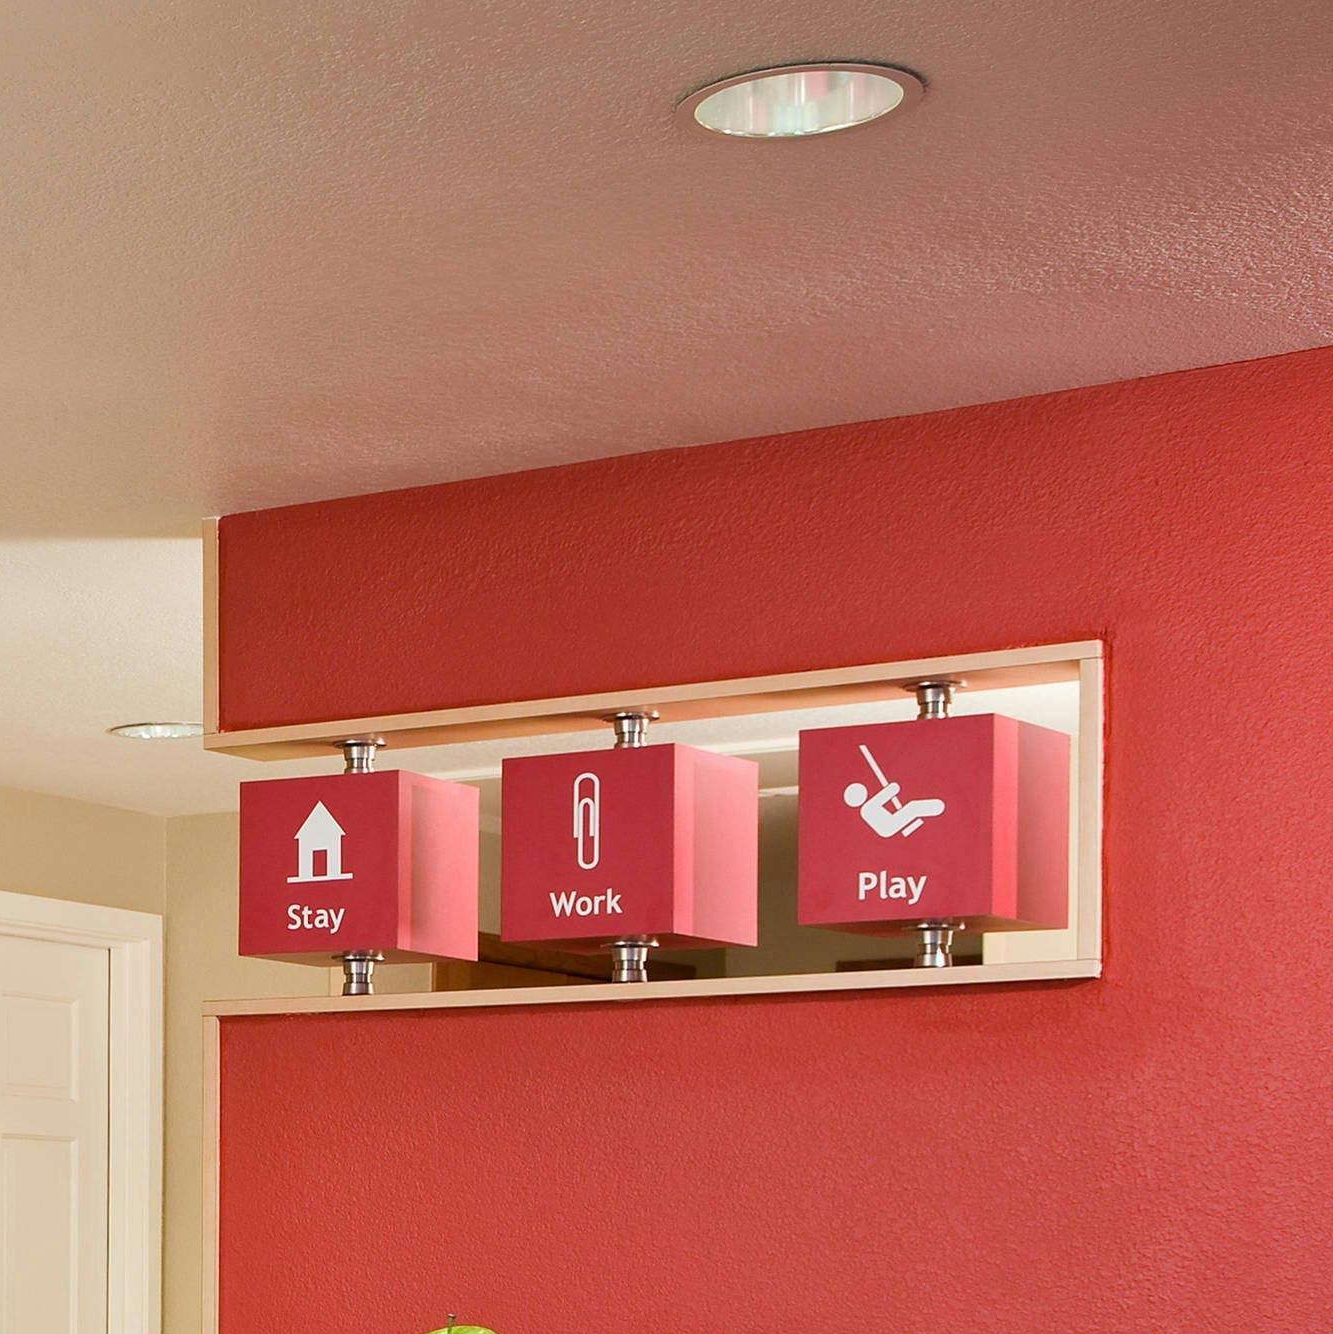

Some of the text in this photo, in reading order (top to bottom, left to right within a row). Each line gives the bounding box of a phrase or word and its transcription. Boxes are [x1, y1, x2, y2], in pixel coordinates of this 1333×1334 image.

[550, 888, 623, 917] Work
[858, 872, 928, 906] Play
[287, 904, 346, 937] Stay
